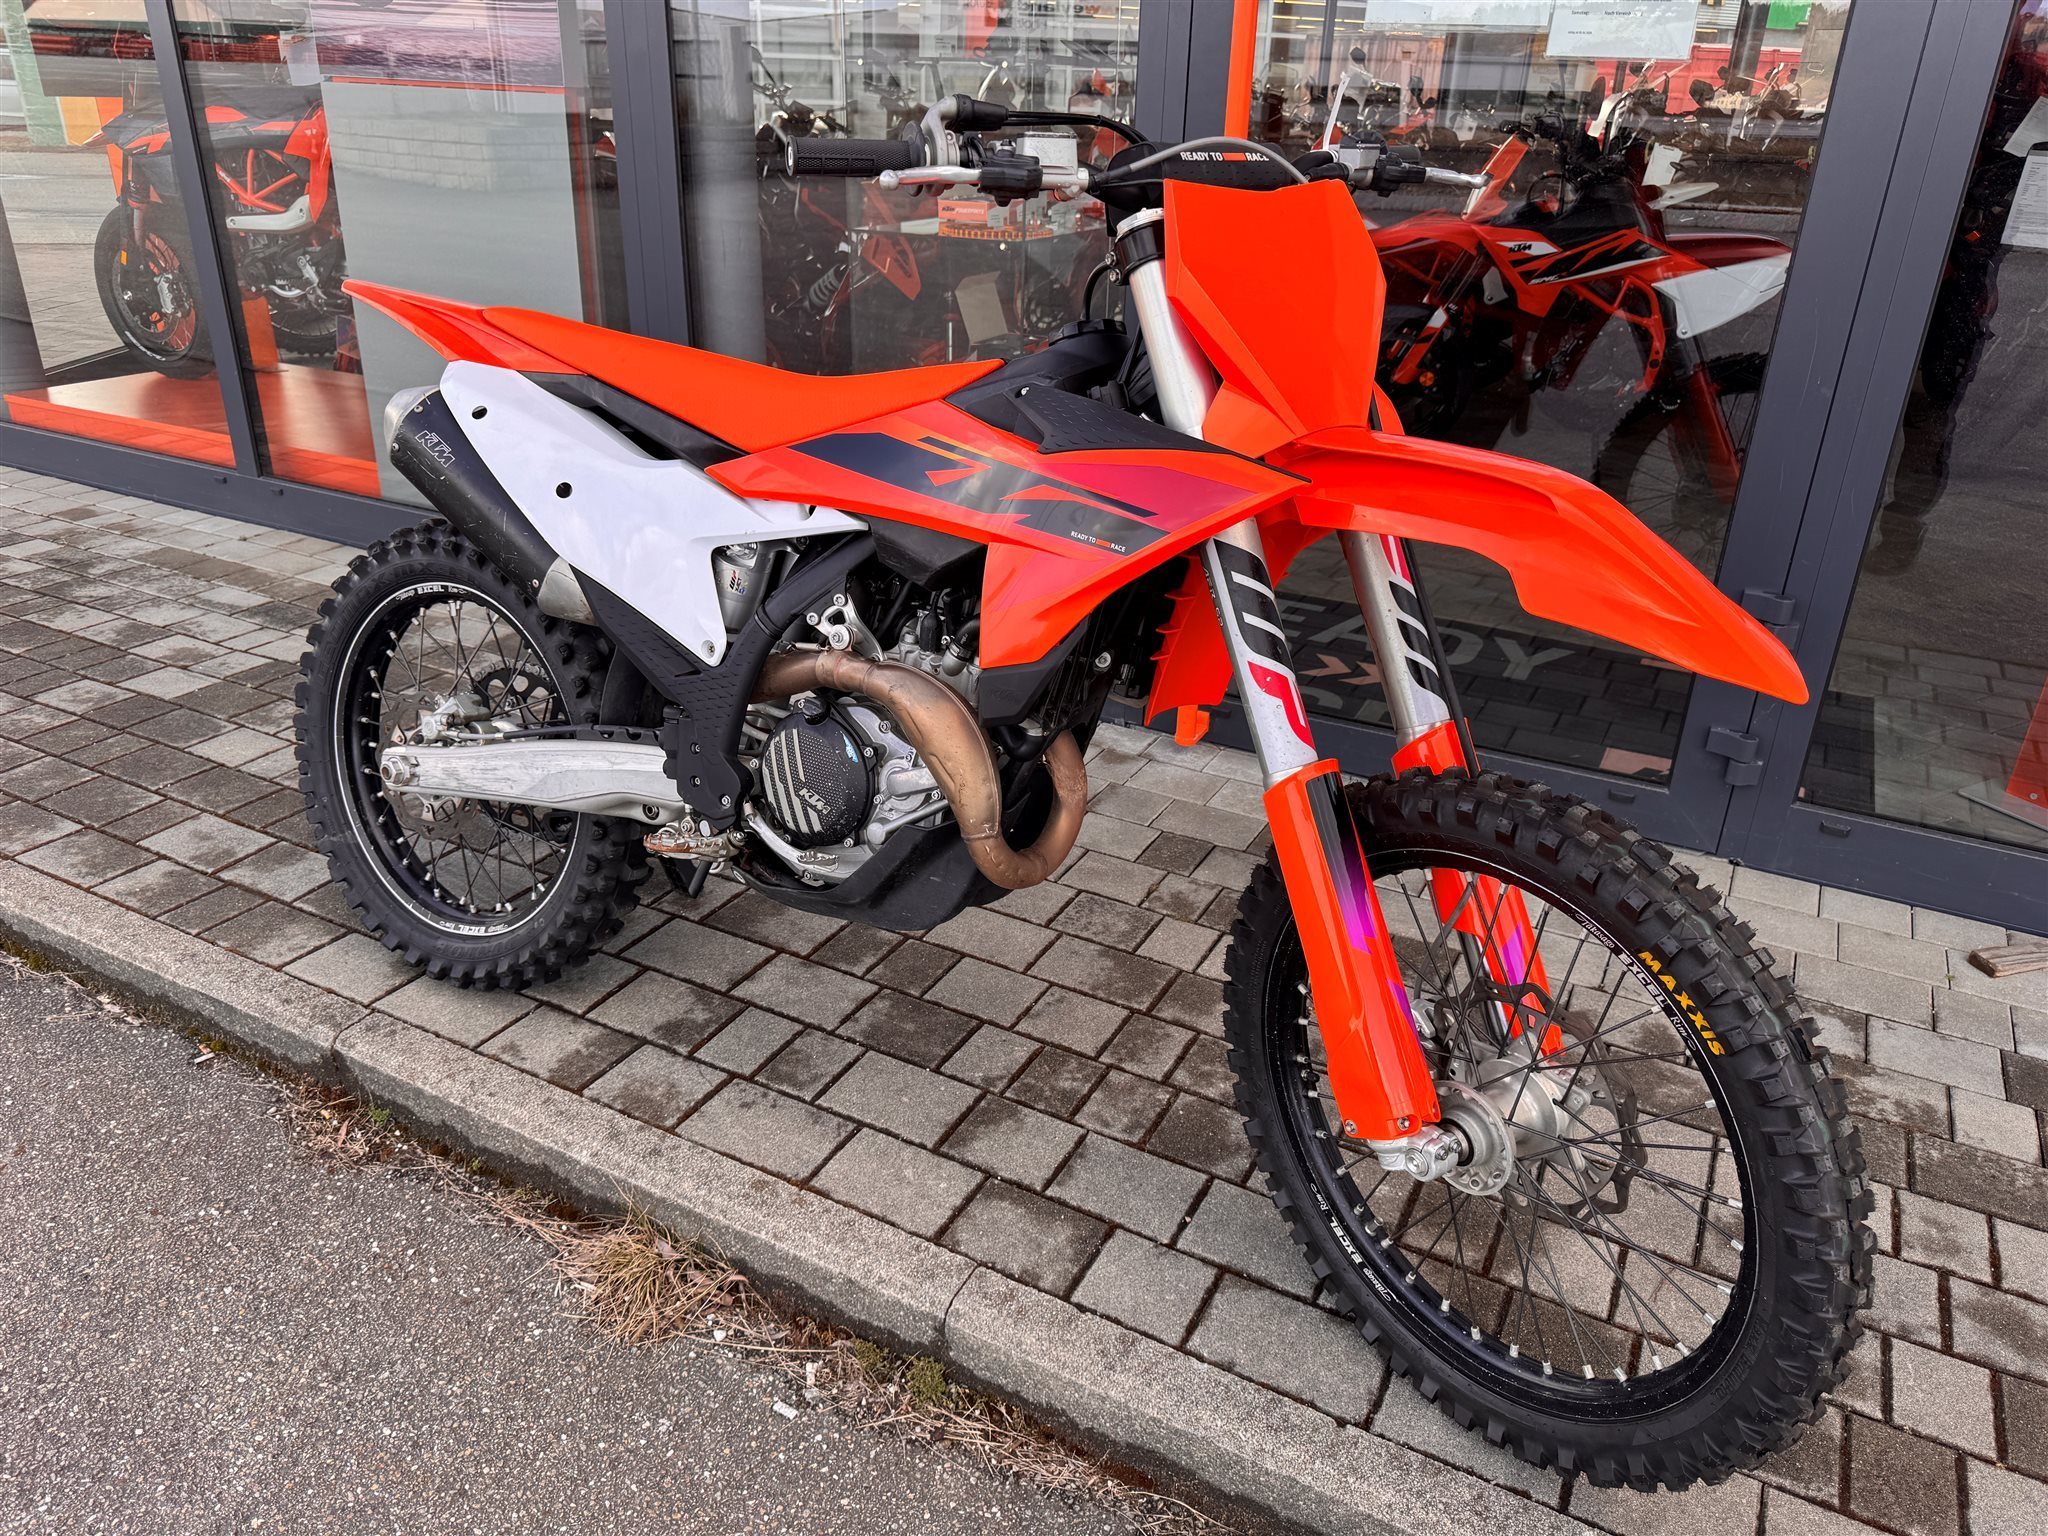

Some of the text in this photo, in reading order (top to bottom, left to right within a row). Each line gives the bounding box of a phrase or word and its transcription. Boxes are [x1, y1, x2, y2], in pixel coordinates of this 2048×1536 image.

[1180, 152, 1208, 160] READY
[1210, 152, 1223, 161] TO
[1508, 243, 1532, 253] KTM
[415, 430, 455, 468] KTM
[1070, 530, 1088, 540] READY
[1110, 543, 1126, 552] RACE
[416, 584, 445, 594] EXCEL
[799, 788, 831, 814] KTM
[458, 924, 487, 934] EXCEL
[1578, 914, 1616, 949] Takasago
[1617, 952, 1669, 1008] EXCEL
[1637, 951, 1726, 1057] MAXXIS
[1329, 1216, 1363, 1265] EXCEL
